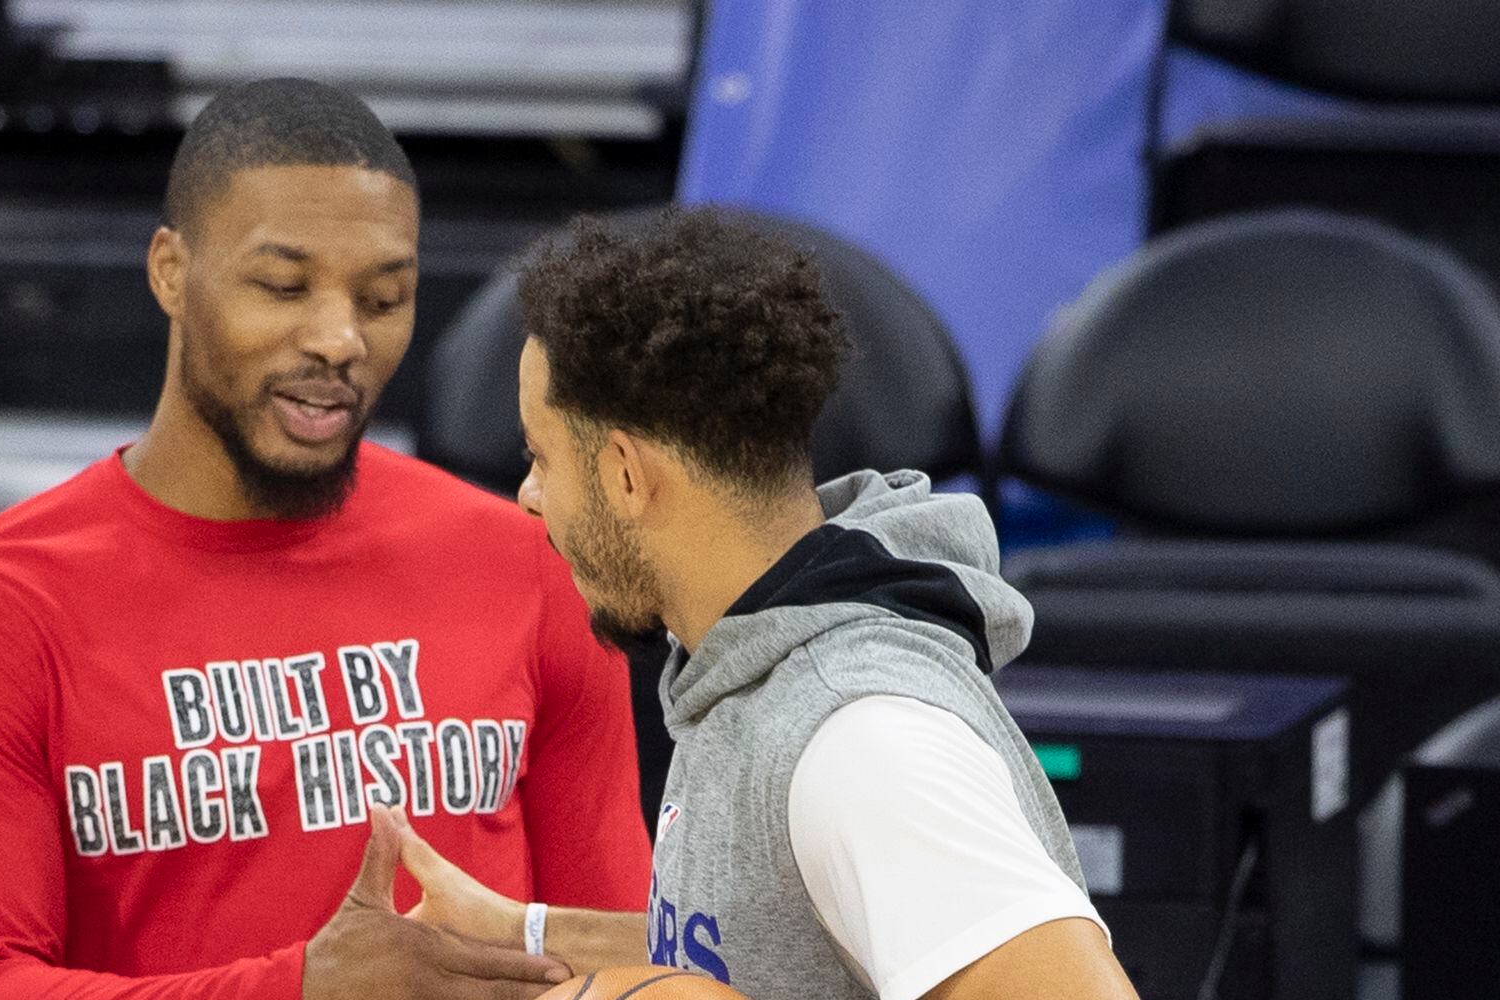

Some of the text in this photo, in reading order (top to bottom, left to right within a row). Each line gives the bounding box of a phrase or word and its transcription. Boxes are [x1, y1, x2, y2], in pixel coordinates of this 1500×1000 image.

[162, 639, 424, 749] BUILT BY
[64, 718, 527, 857] BLACK HISTORY
